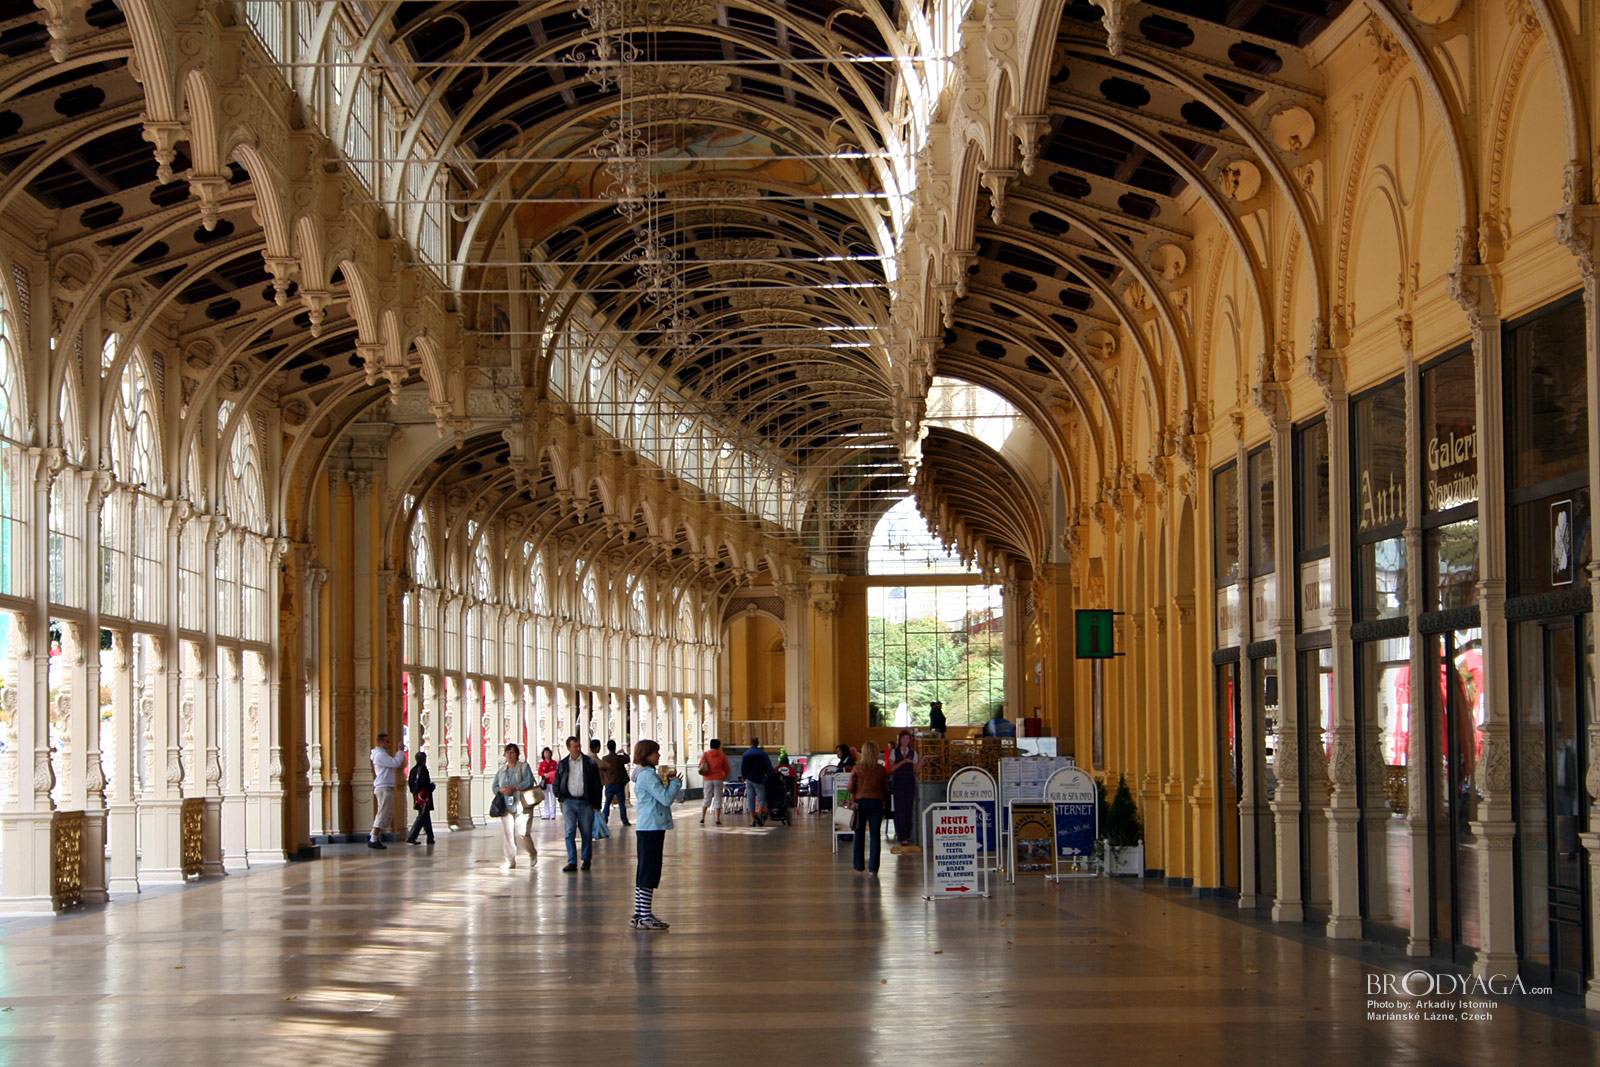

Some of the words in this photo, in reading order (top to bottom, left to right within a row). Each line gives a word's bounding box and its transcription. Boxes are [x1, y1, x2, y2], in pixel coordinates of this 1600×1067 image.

[1428, 425, 1477, 471] Galeri
[952, 790, 963, 799] KUR
[964, 790, 969, 798] &
[970, 790, 979, 798] SPA
[981, 789, 992, 798] INFO
[1079, 792, 1092, 800] INFO
[1054, 804, 1092, 815] NTERNET
[941, 816, 968, 825] HEUTE
[935, 826, 975, 835] ANGEBOT
